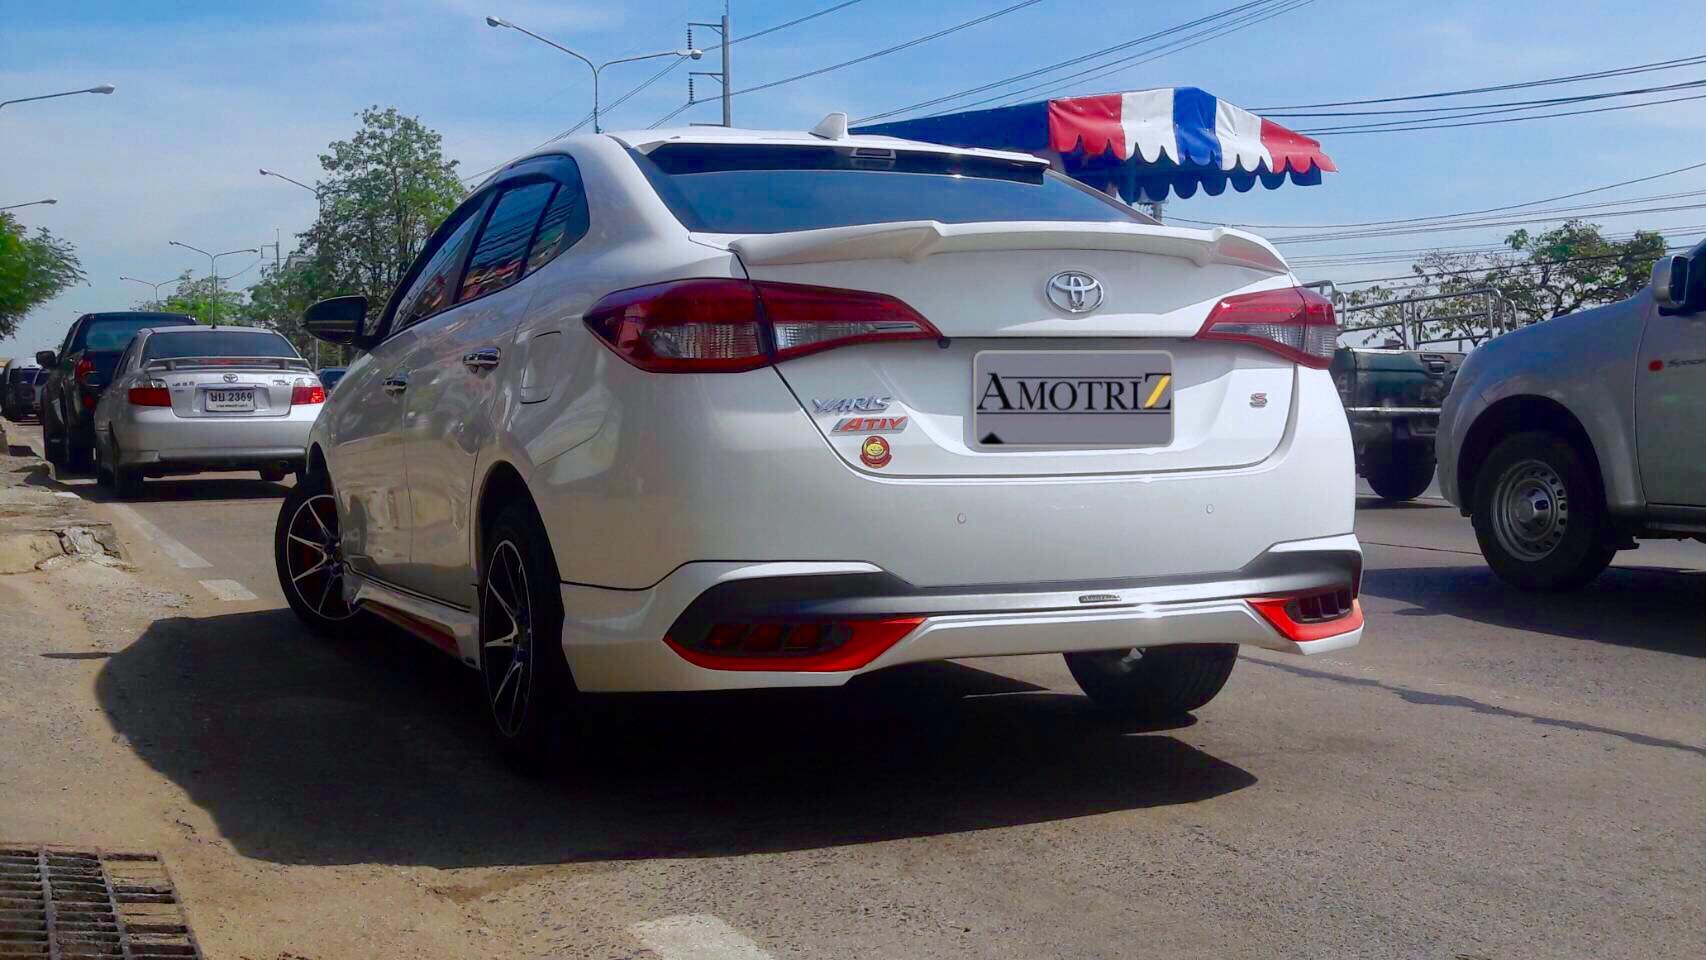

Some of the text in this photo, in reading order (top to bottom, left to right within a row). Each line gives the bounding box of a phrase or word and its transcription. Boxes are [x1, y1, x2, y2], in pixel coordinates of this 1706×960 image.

[228, 391, 253, 402] 2369
[812, 395, 891, 414] YARIS
[1250, 392, 1268, 408] S
[839, 415, 908, 432] ATIV
